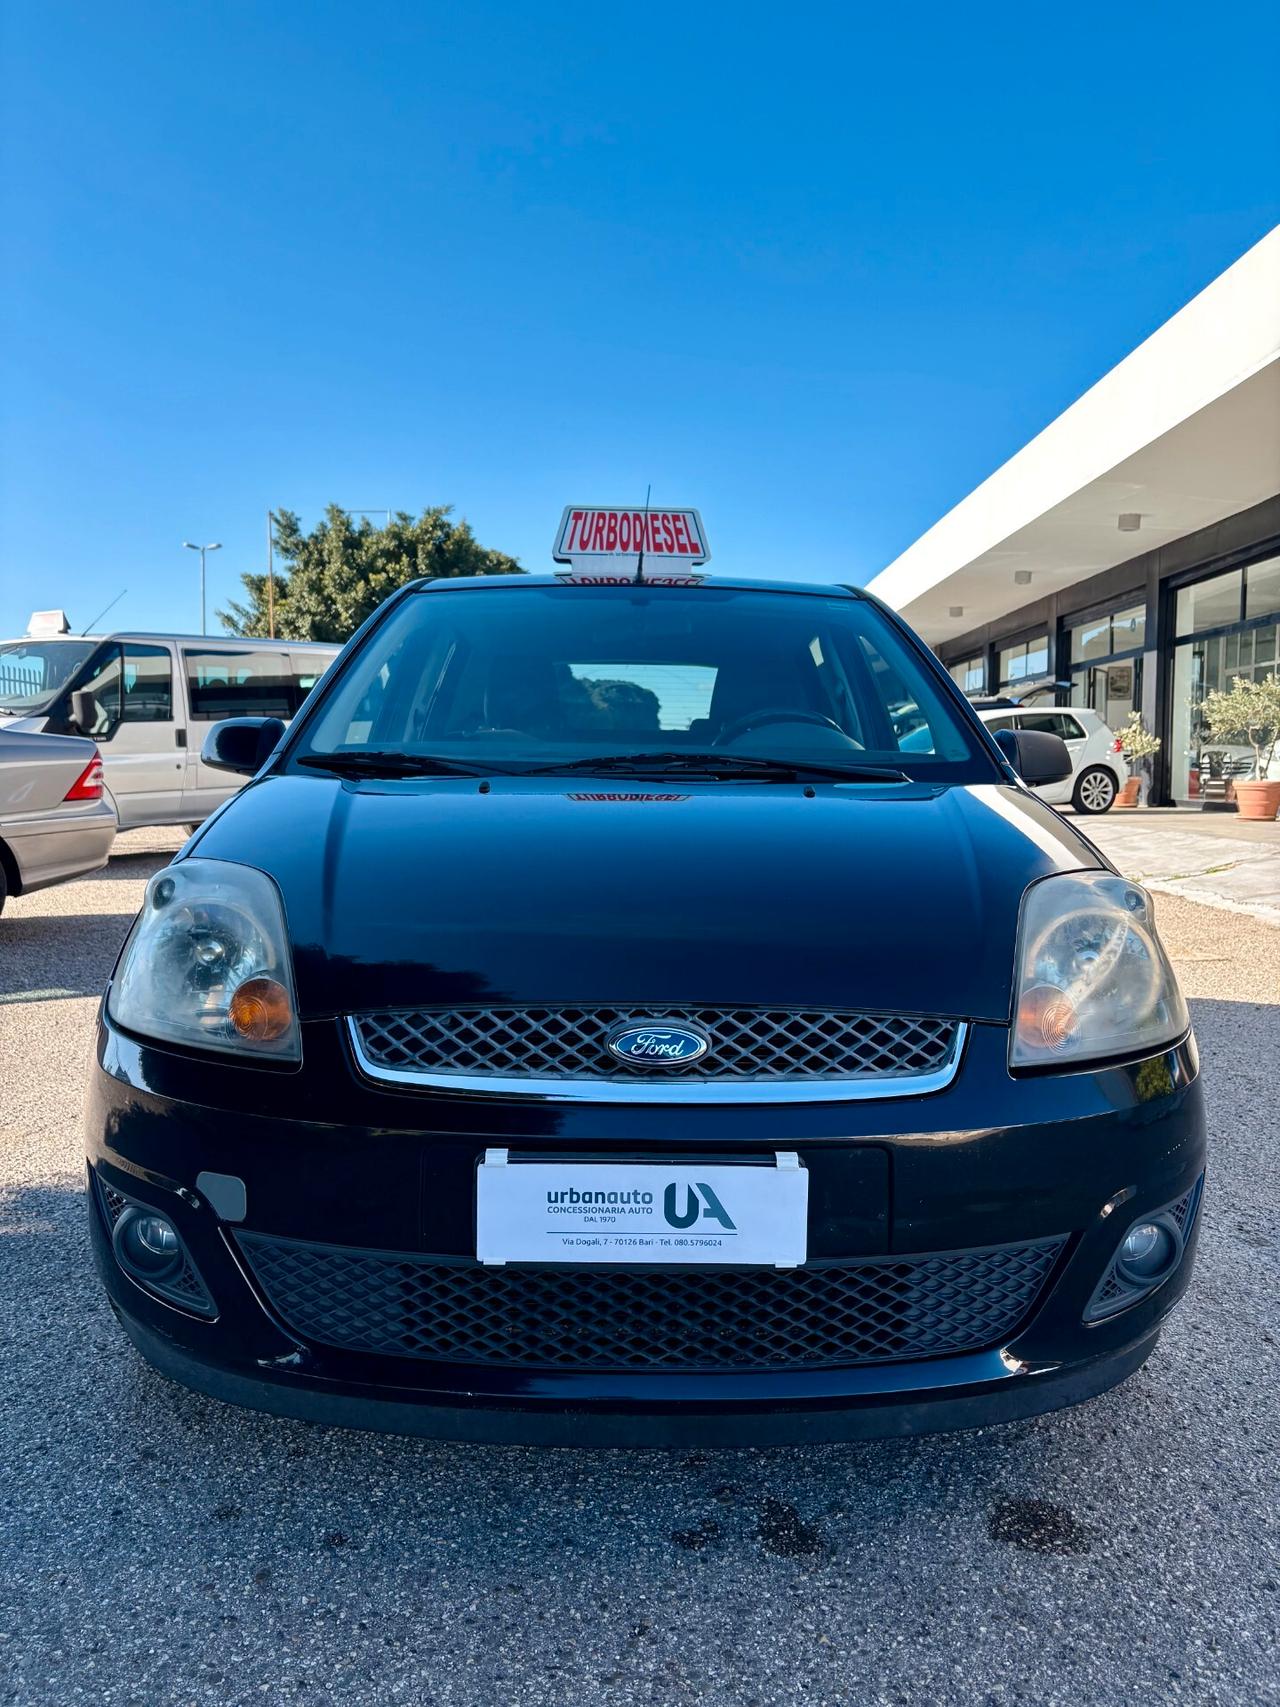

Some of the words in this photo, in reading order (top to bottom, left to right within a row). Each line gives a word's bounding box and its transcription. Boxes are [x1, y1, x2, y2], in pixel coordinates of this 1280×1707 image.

[568, 511, 701, 554] TURBODIESEL
[630, 1033, 684, 1056] Ford
[547, 1187, 653, 1204] urbanauto
[547, 1206, 626, 1214] CONCESSIONARIA
[628, 1206, 653, 1215] AUTO
[663, 1182, 737, 1230] UA
[576, 1238, 602, 1246] Dogali,
[614, 1238, 638, 1246] 70126
[638, 1238, 654, 1246] Bari
[674, 1239, 722, 1247] 080.5796024
